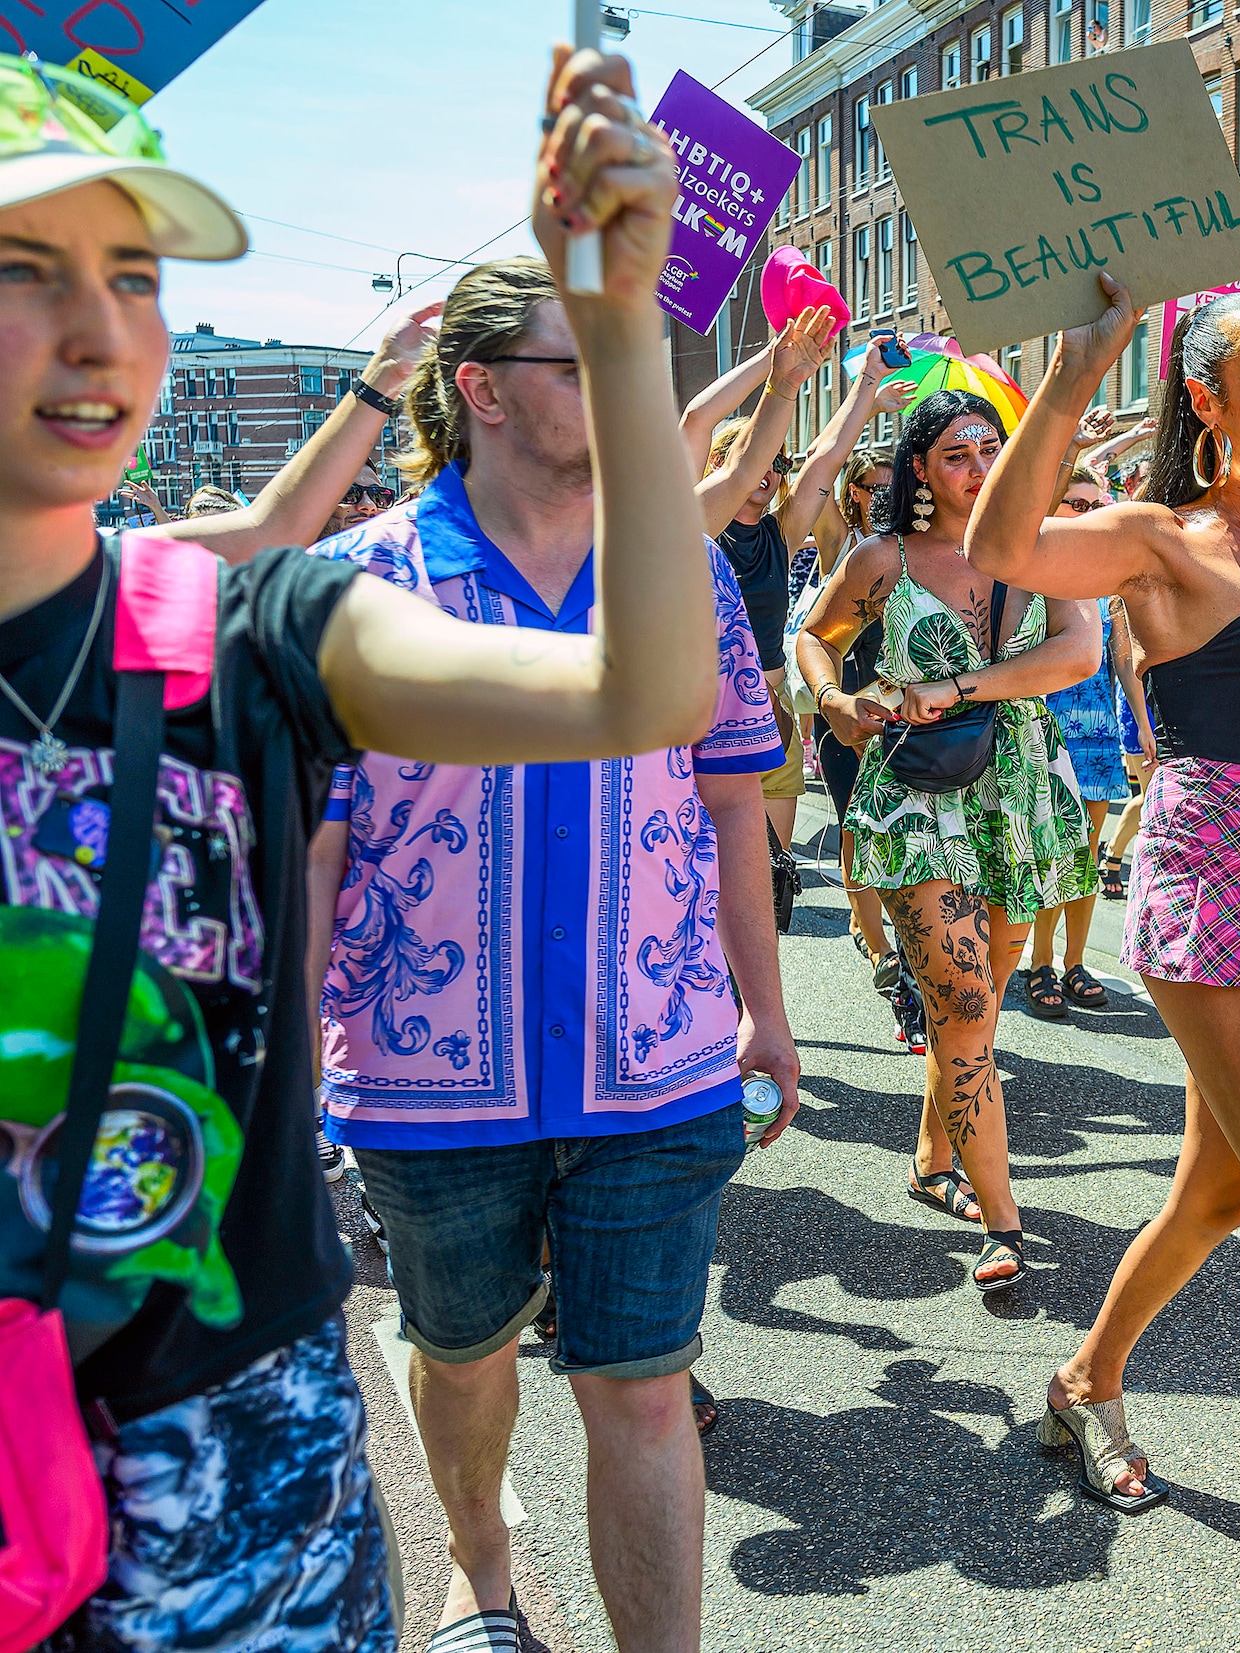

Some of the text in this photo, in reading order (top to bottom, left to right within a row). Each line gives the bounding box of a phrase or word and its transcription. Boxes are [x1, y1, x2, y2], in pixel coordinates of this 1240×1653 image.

[924, 73, 1150, 159] TRANS
[1052, 162, 1102, 205] IS
[672, 164, 756, 227] elzoekers
[661, 270, 684, 287] Asylum
[665, 262, 689, 281] LGBT
[658, 275, 682, 293] Support
[663, 296, 673, 306] the
[671, 303, 693, 318] protest
